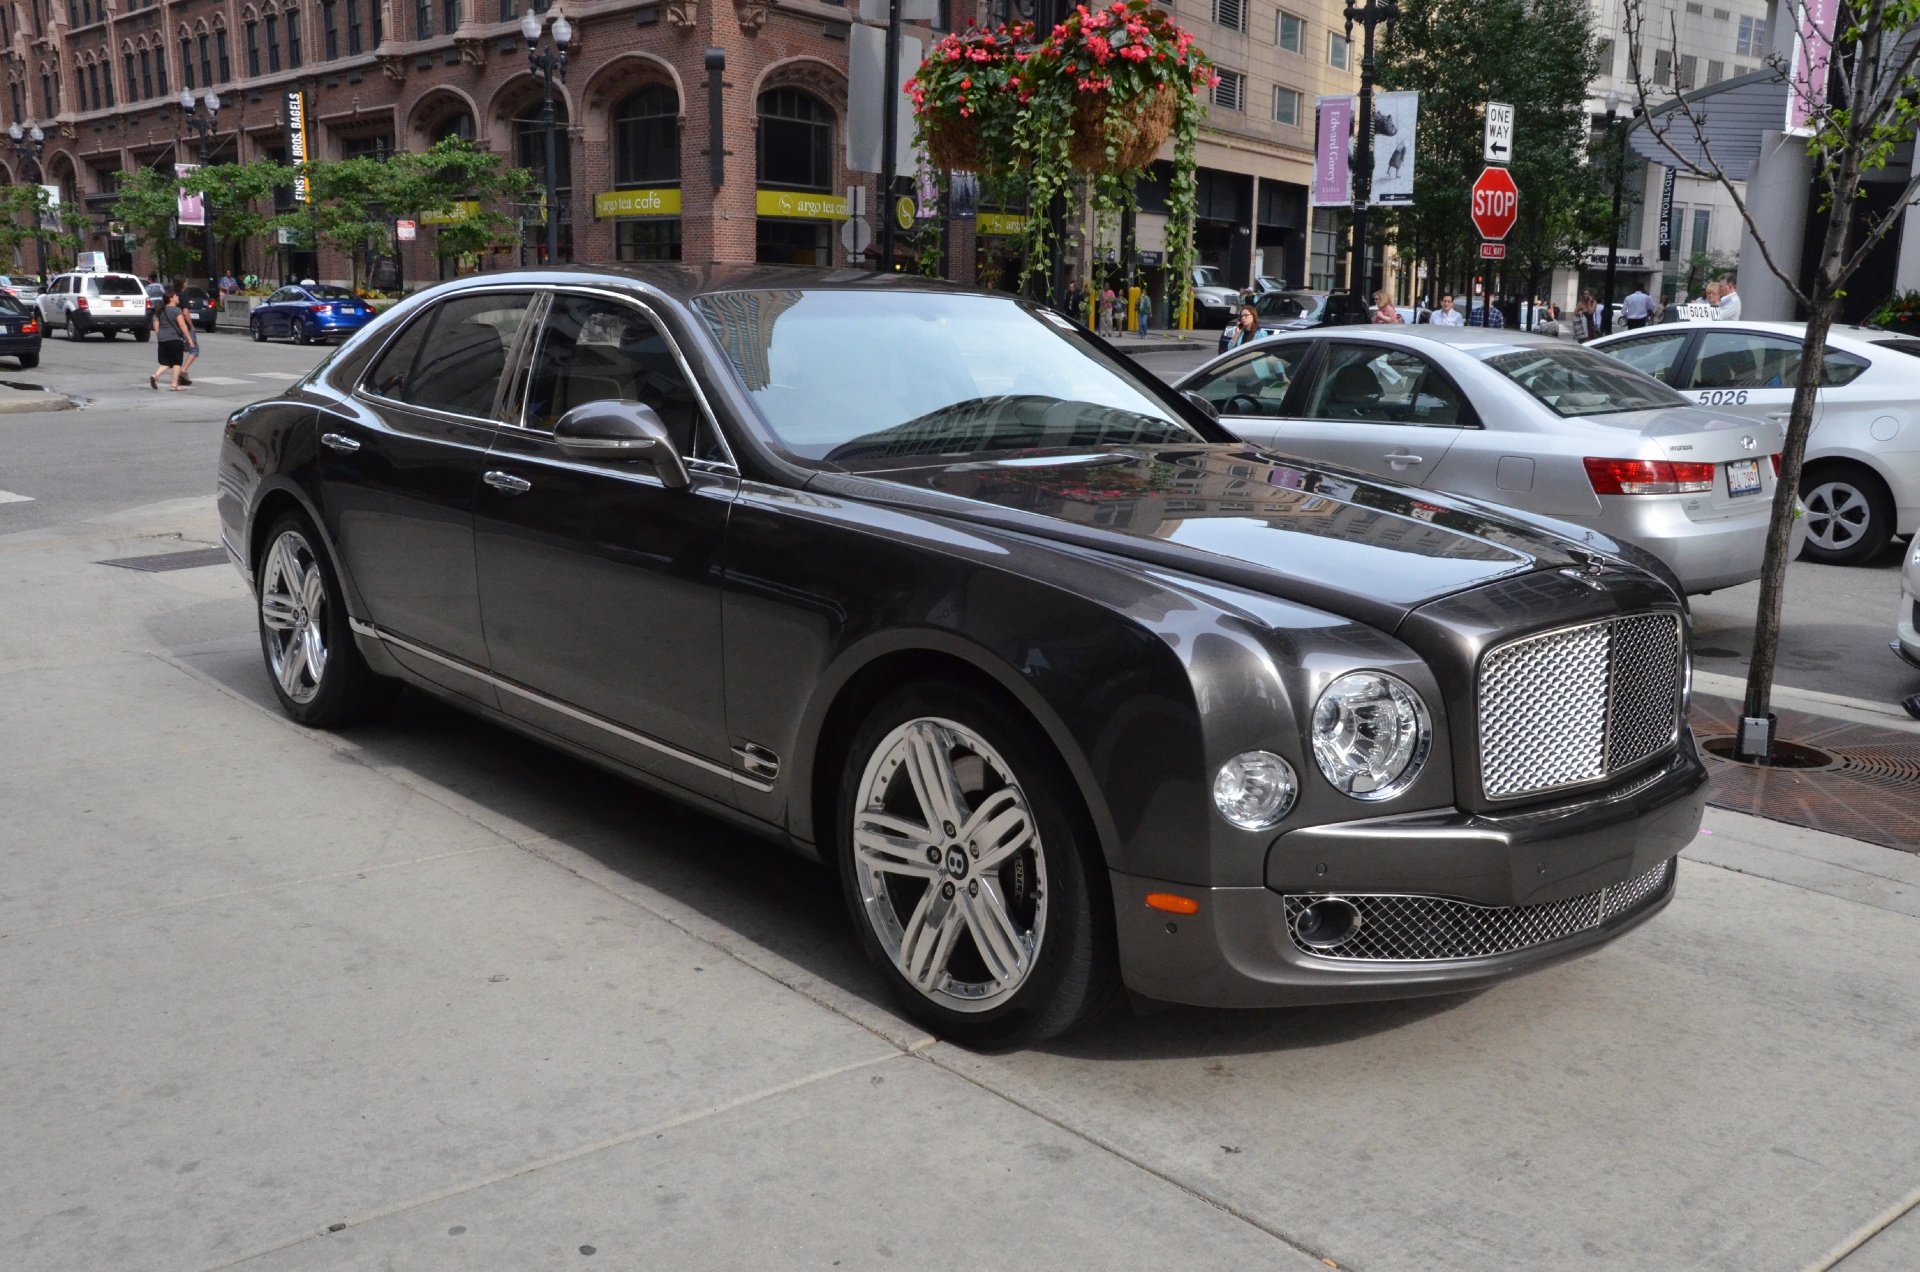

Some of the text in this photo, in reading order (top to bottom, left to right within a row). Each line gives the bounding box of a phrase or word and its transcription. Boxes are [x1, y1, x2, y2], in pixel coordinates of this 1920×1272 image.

[1490, 108, 1511, 124] ONE
[1329, 111, 1340, 150] Edward
[1489, 124, 1510, 139] WAY
[289, 92, 306, 201] EINSTN BROS. BAGELS
[1324, 151, 1338, 183] Gorey
[619, 198, 632, 211] tea
[634, 191, 661, 209] café
[797, 200, 821, 216] argo
[822, 201, 835, 214] tea
[1475, 189, 1515, 217] STOP
[1660, 167, 1674, 246] ORDSTROM rack
[1482, 246, 1503, 257] ALL WAY
[1628, 253, 1644, 265] rack
[1690, 305, 1709, 318] 5026
[1698, 390, 1749, 406] 5026
